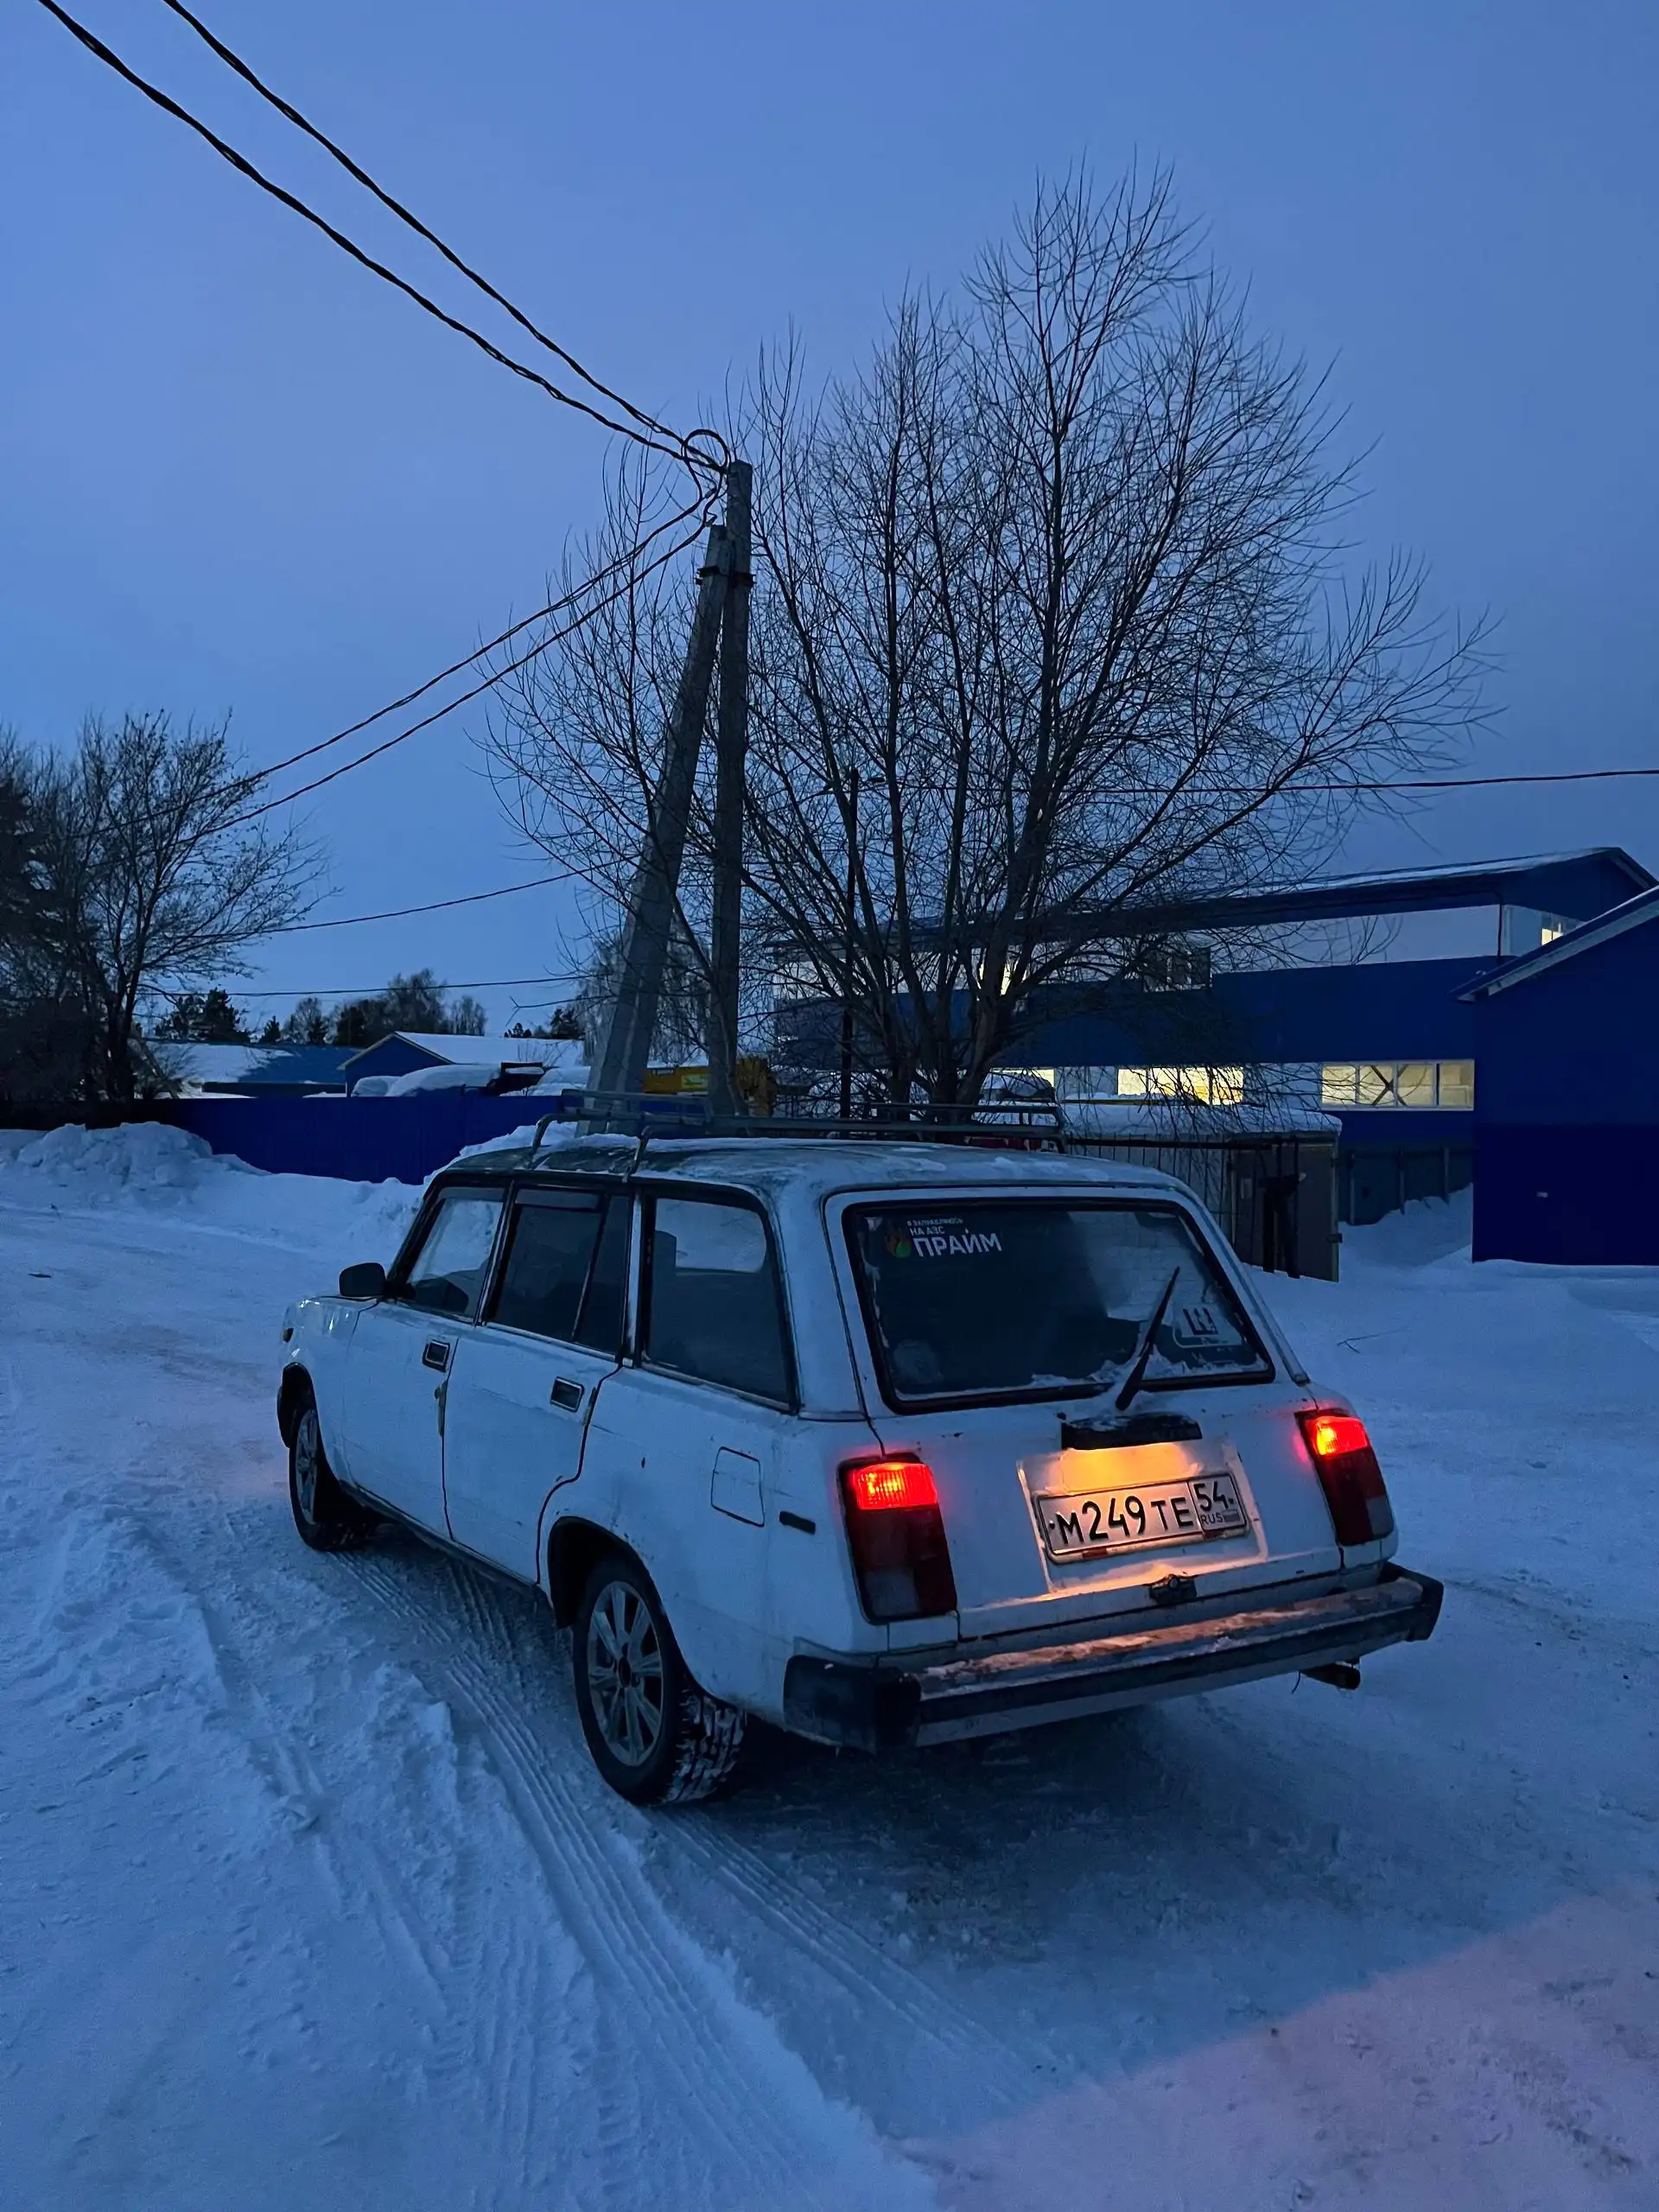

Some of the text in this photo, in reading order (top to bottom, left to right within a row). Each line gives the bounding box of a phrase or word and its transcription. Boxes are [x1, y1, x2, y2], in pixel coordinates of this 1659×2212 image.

[909, 1225, 946, 1236] НА АЗС
[912, 1226, 1003, 1258] ПРАЙМ
[1193, 1481, 1229, 1511] 54
[1199, 1513, 1224, 1526] RUS
